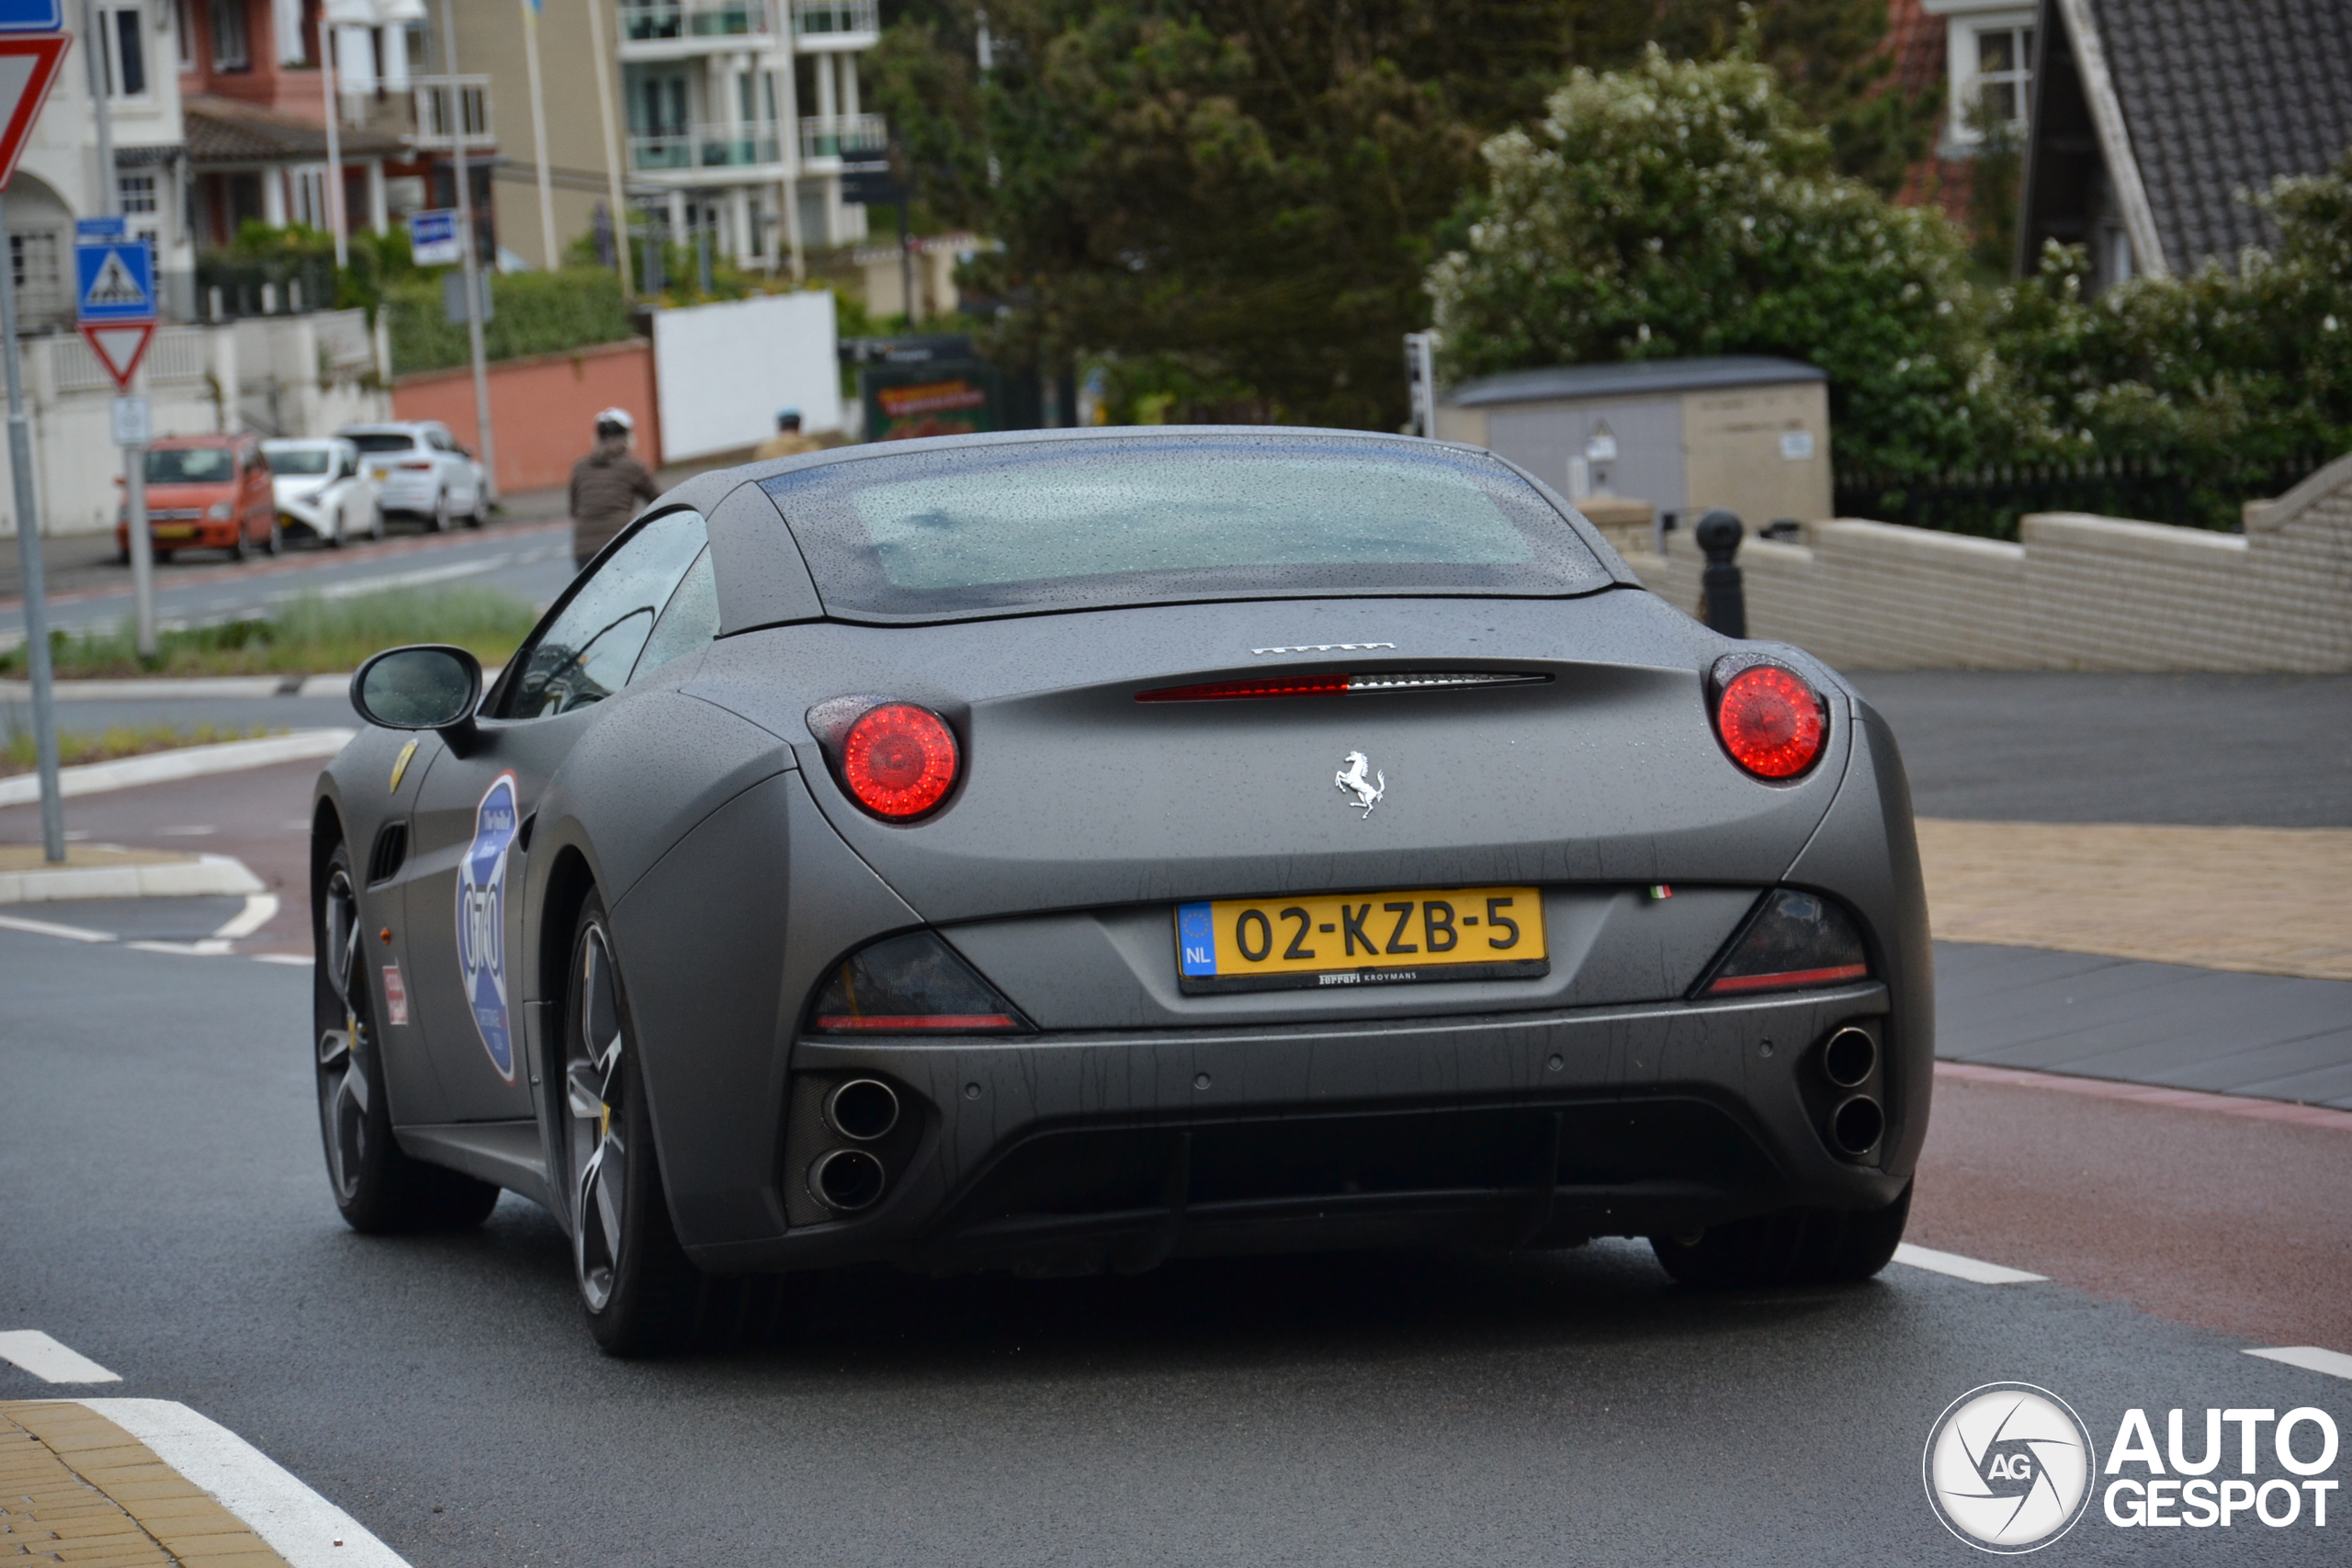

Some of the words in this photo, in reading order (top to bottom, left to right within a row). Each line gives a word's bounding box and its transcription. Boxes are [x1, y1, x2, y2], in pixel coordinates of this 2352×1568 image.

[1236, 897, 1521, 962] 02-KZB-5
[1186, 946, 1212, 964] NL
[1319, 973, 1361, 985] Ferrari
[1364, 972, 1417, 982] KROYMANS
